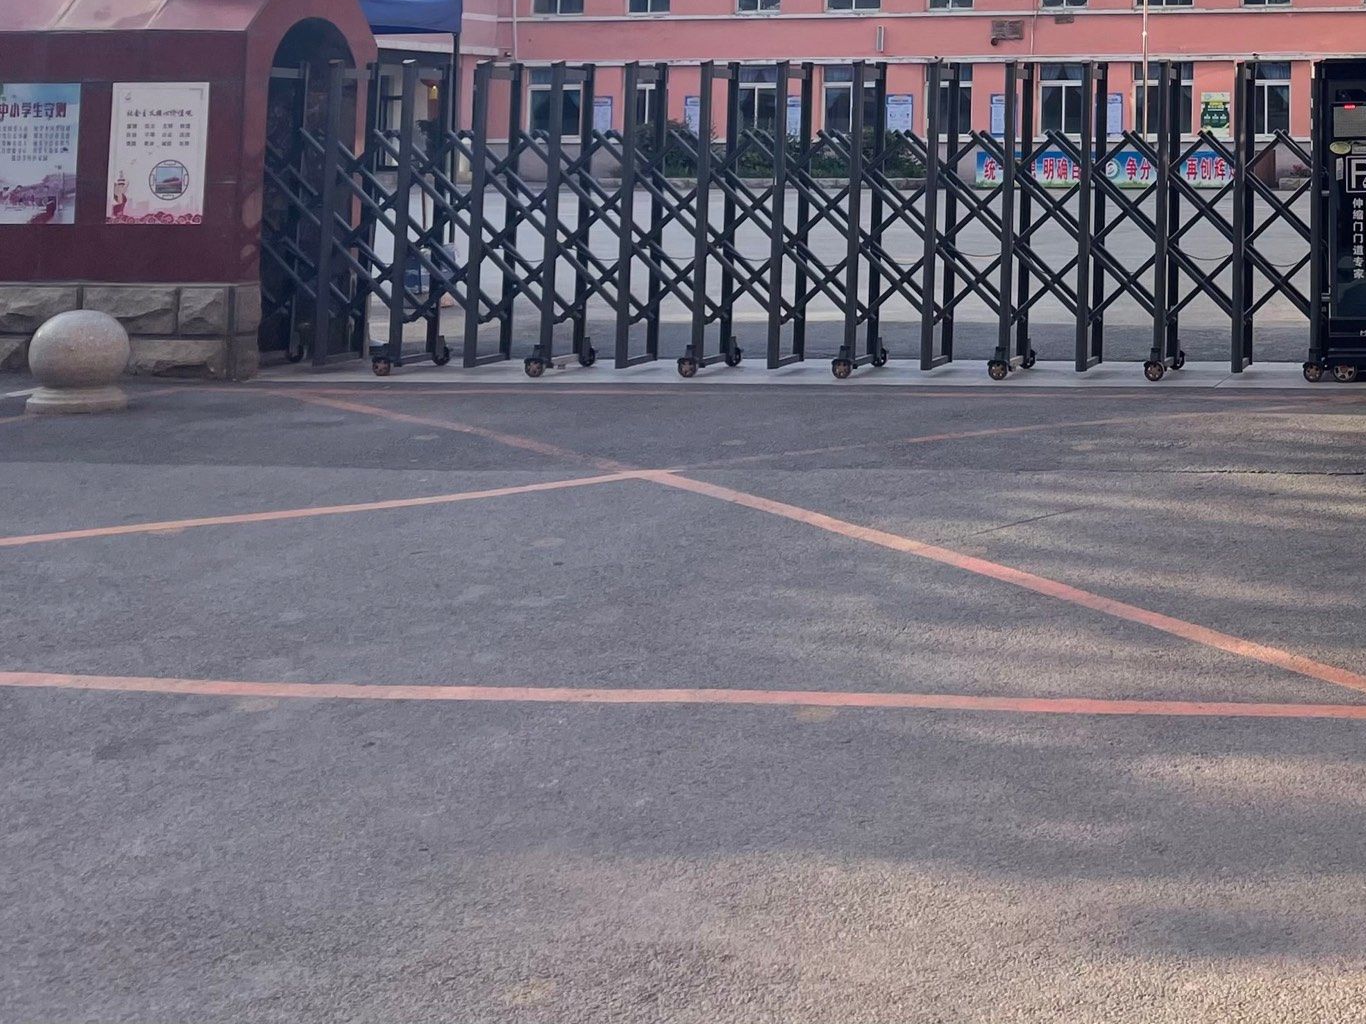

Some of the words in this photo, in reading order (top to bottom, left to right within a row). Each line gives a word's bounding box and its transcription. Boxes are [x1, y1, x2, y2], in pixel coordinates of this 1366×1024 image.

[1186, 158, 1234, 180] 再创辉
[1352, 198, 1364, 279] 伸缩门门道专家
